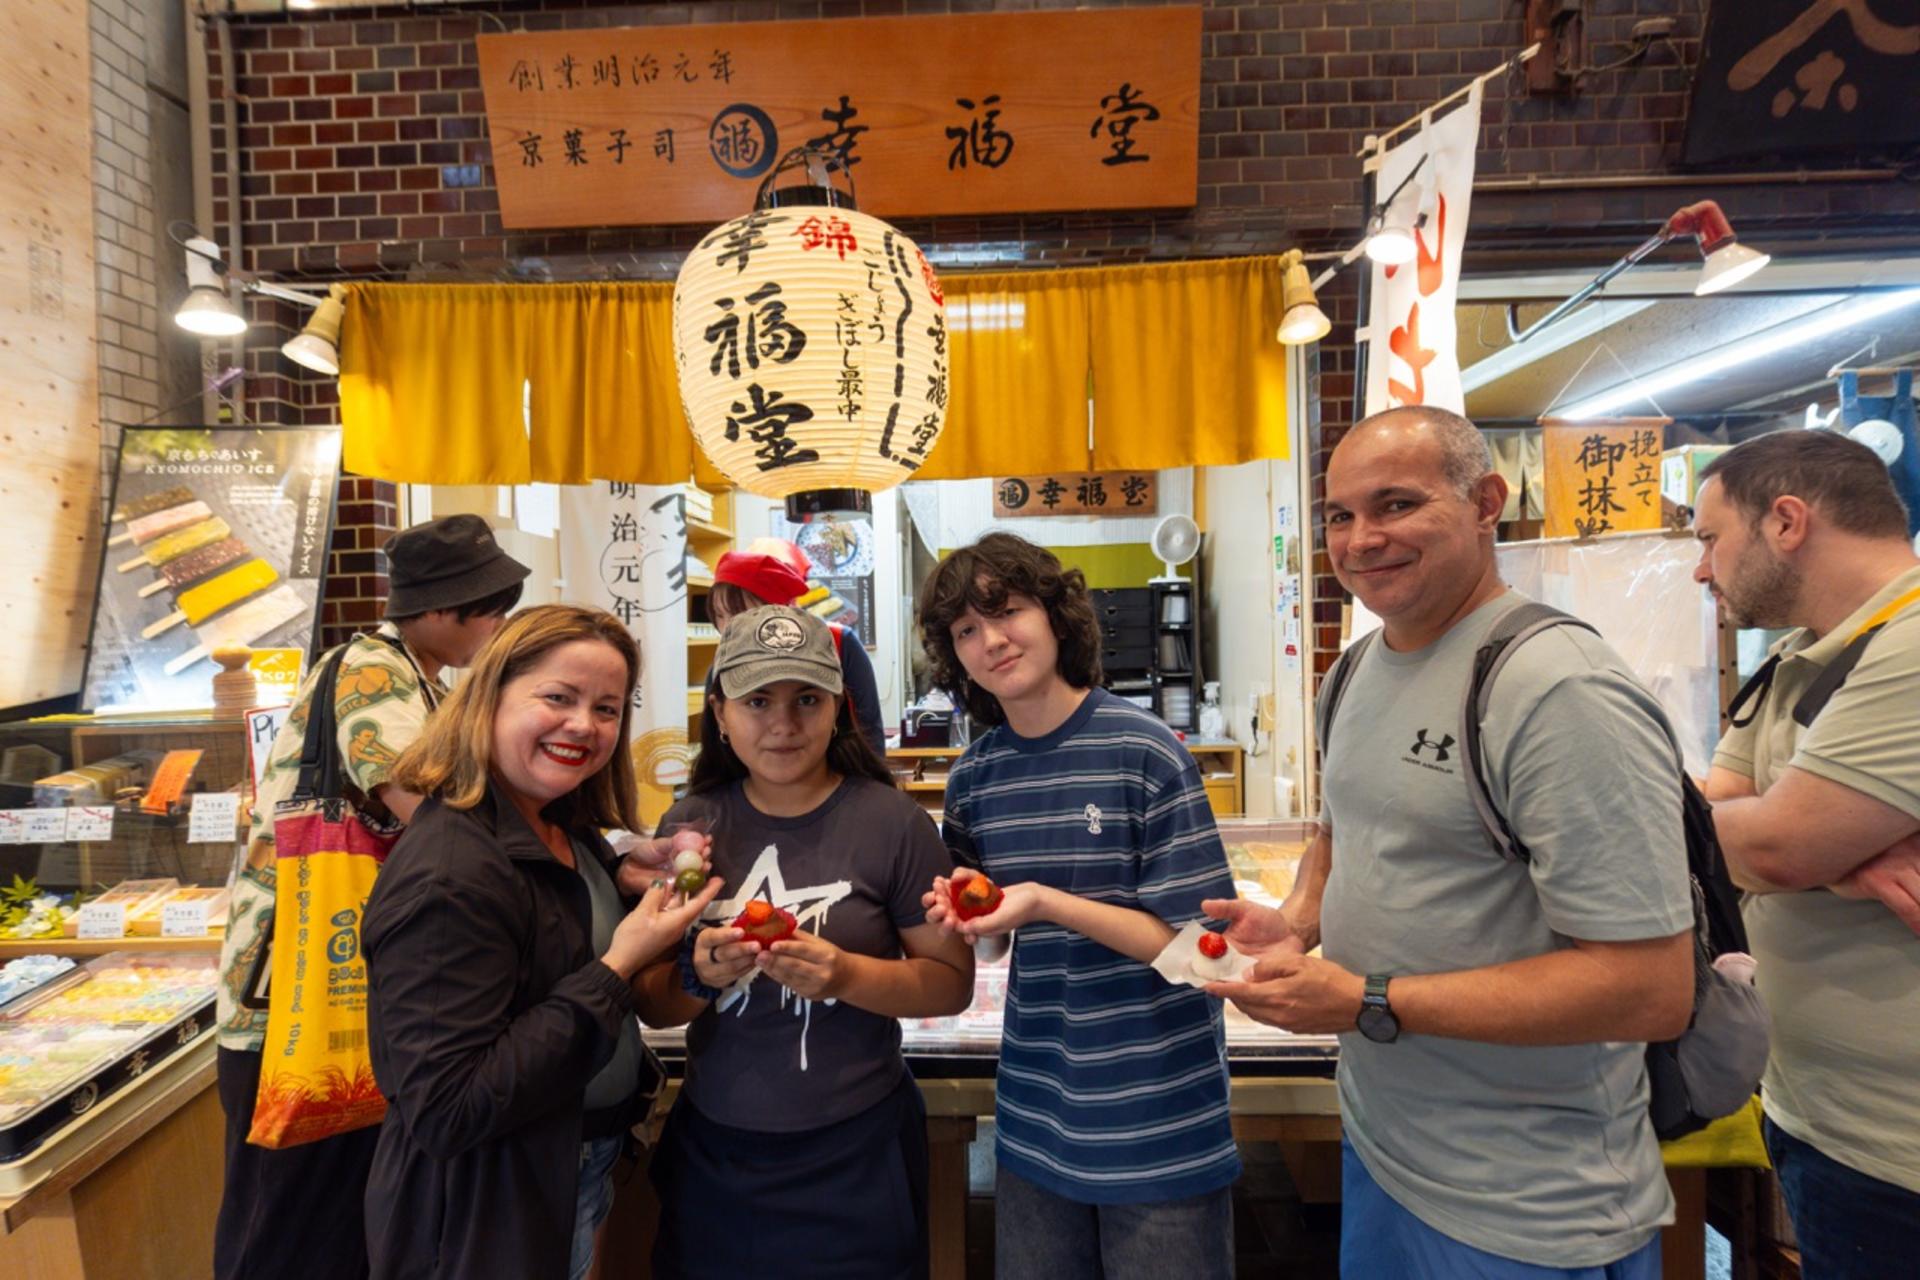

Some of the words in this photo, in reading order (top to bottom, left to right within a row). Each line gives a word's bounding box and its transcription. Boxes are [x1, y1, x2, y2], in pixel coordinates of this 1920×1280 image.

[509, 50, 736, 92] 創業明治元年
[518, 127, 675, 168] 京菓子司
[806, 83, 1160, 172] 幸福堂
[789, 215, 858, 262] 錦
[863, 248, 886, 344] ごじょう
[700, 210, 820, 472] 幸福堂
[145, 464, 230, 474] KYOMOCHI
[248, 464, 275, 474] ICE
[1036, 475, 1149, 510] 幸福堂
[1628, 430, 1660, 507] 挽立て
